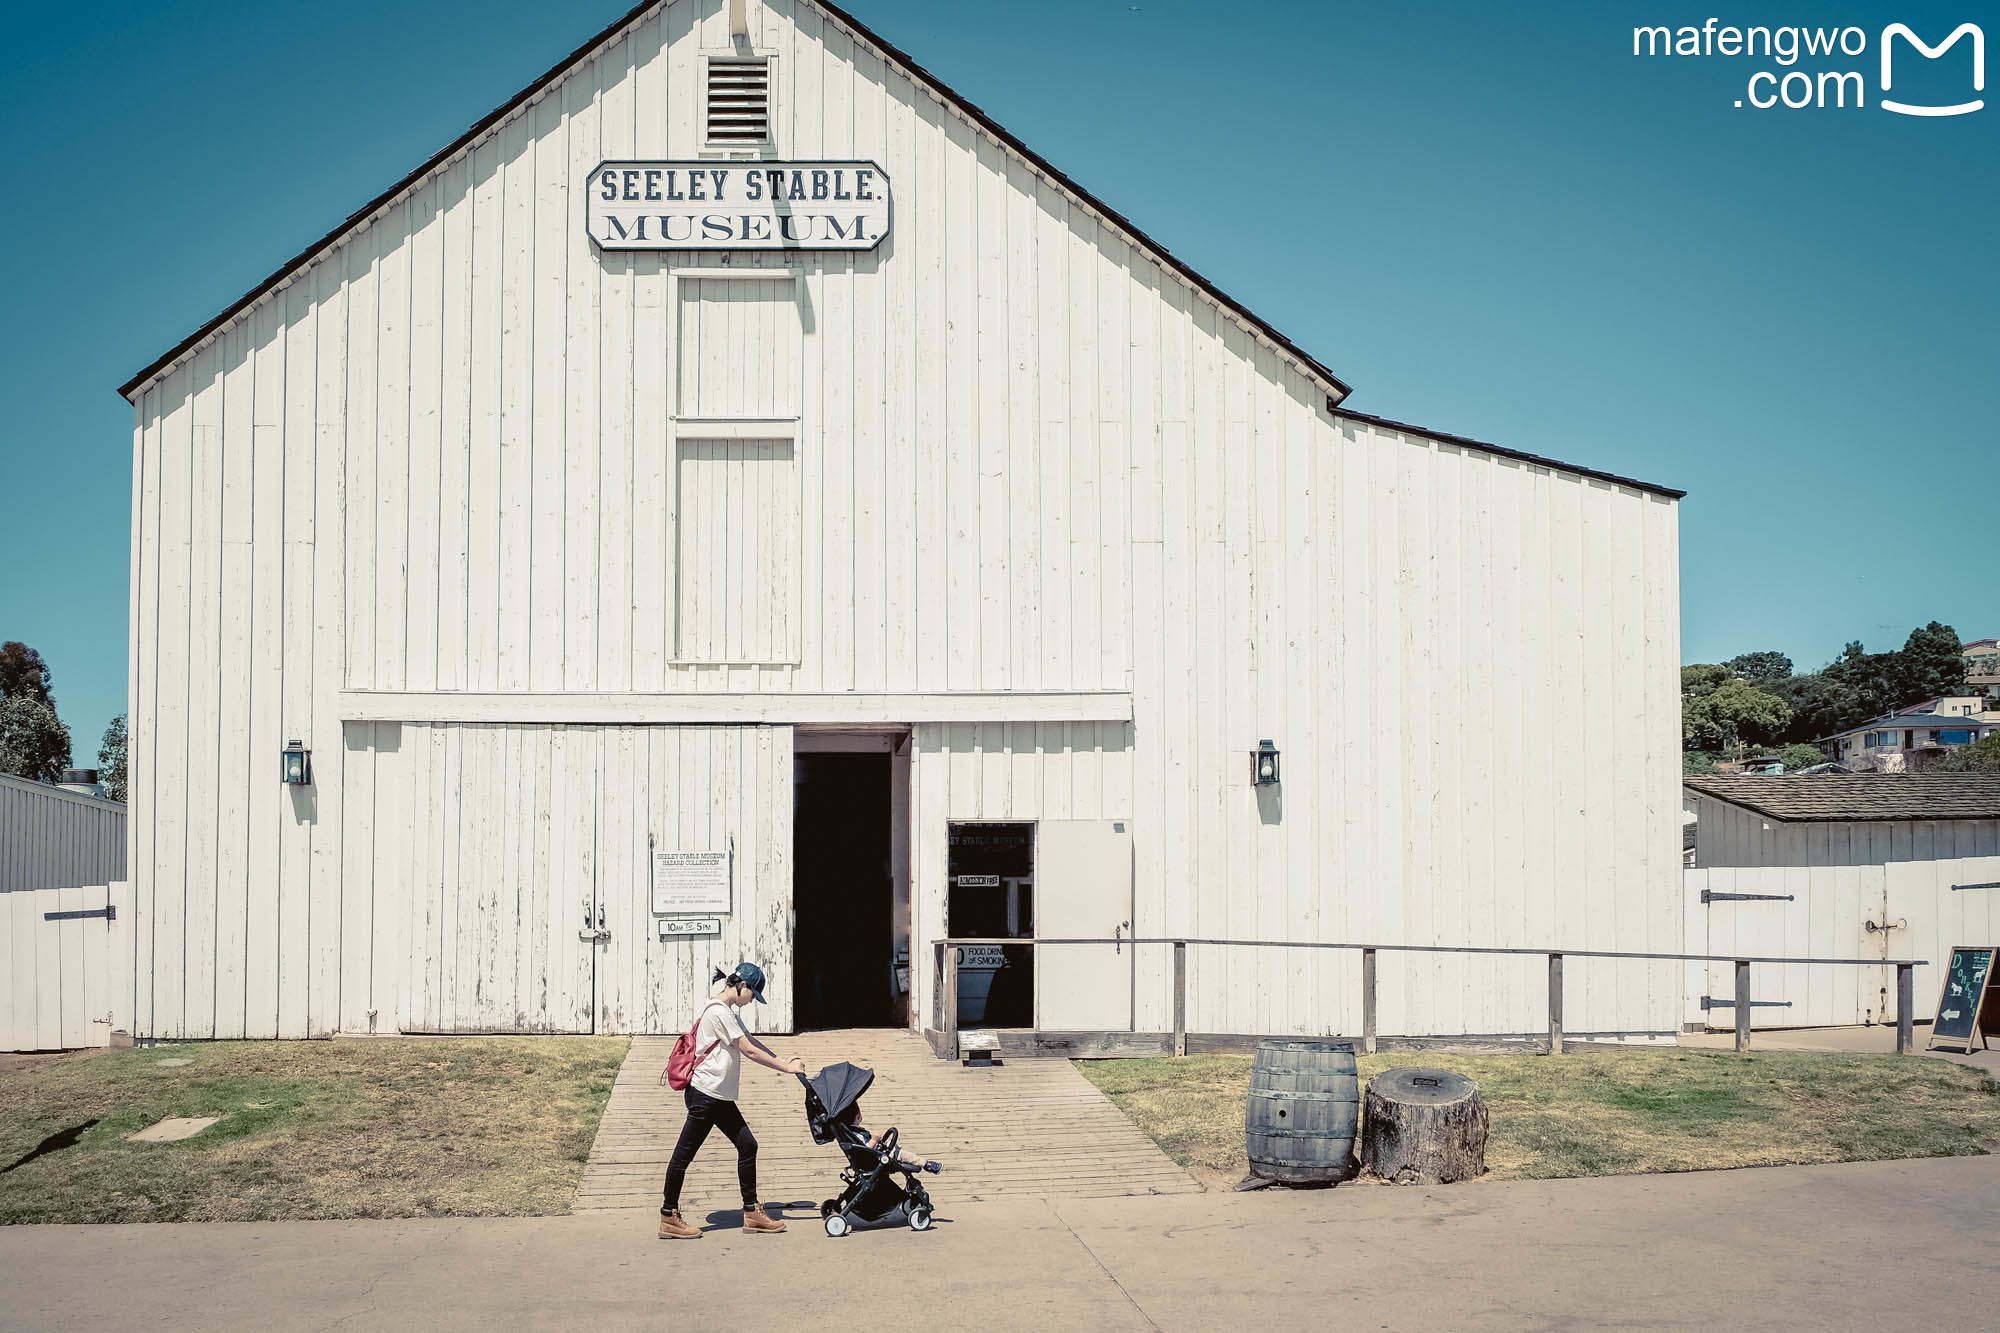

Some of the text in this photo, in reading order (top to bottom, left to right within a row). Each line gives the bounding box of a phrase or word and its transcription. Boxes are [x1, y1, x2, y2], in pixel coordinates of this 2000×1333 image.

[601, 169, 882, 201] SEELEY STABLE.
[601, 214, 879, 241] MUSEUM.
